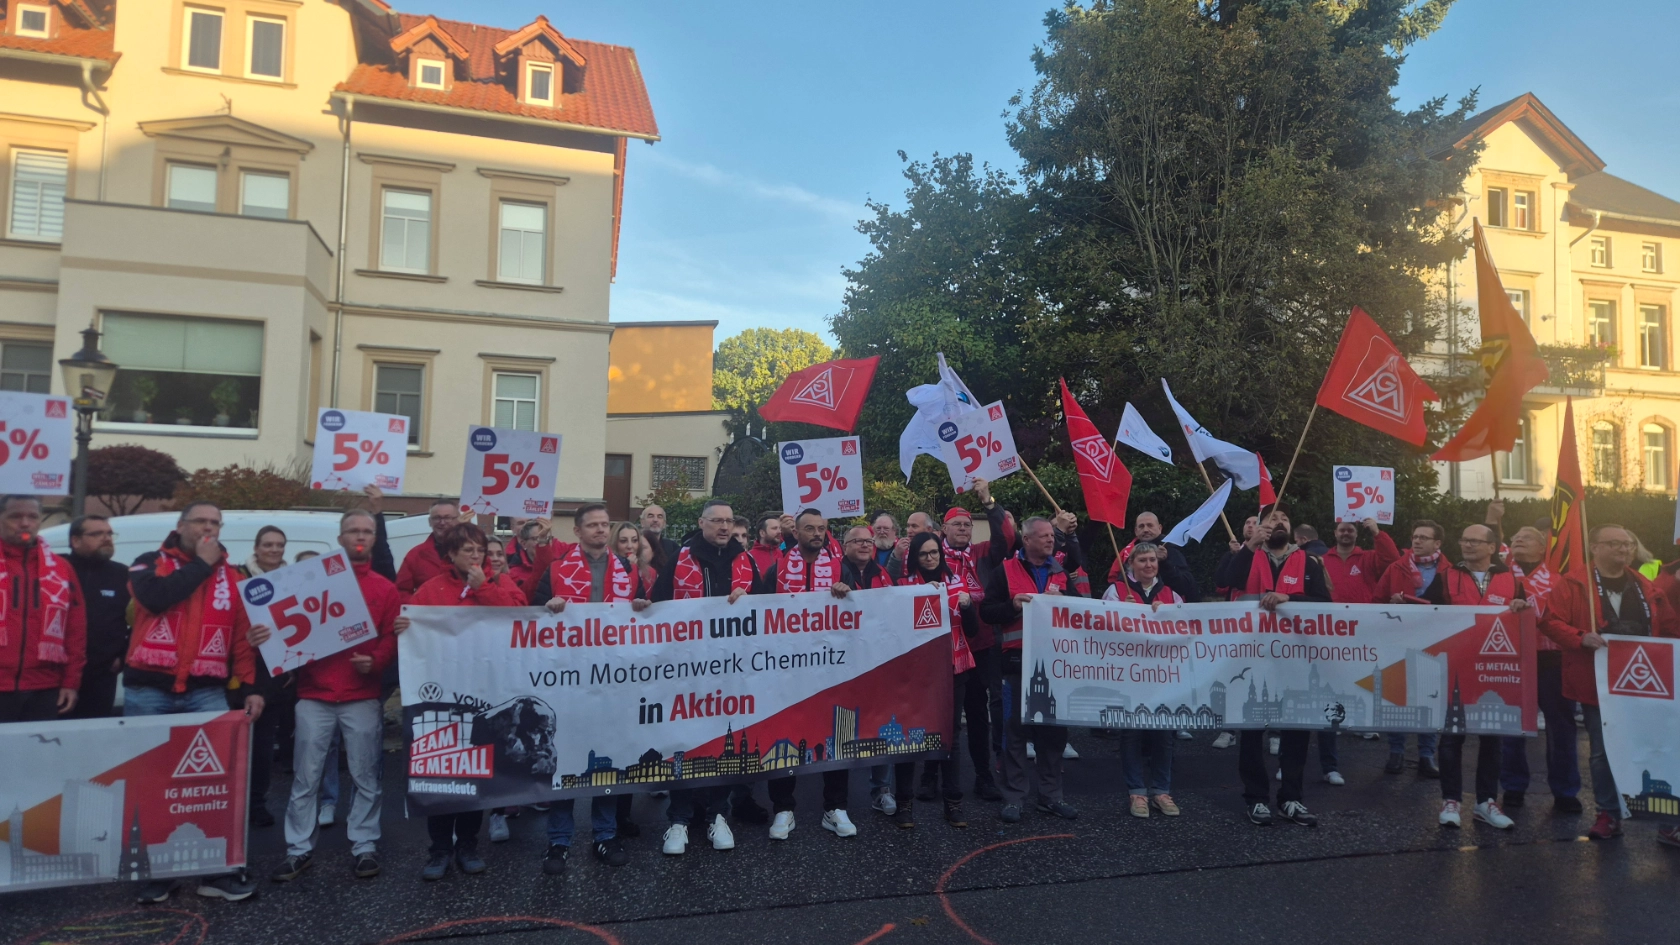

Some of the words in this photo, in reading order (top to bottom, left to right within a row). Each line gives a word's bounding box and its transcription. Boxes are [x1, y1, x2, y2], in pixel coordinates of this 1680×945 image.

[475, 434, 492, 442] WIR
[941, 426, 954, 435] WIR
[332, 433, 389, 471] 5%
[785, 448, 799, 456] WIR
[954, 431, 1003, 474] 5%
[482, 453, 540, 496] 5%
[795, 462, 848, 504] 5%
[1346, 482, 1385, 510] 5%
[248, 584, 268, 597] WIR
[268, 590, 345, 649] 5%
[510, 618, 703, 648] Metallerinnen
[710, 609, 757, 638] und
[763, 605, 862, 634] Metaller
[1051, 606, 1201, 636] Metallerinnen
[1208, 611, 1253, 635] und
[1258, 611, 1358, 637] Metaller
[1052, 638, 1079, 654] von
[1083, 637, 1190, 663] thyssenkrupp
[1194, 639, 1265, 663] Dynamic
[1270, 639, 1378, 663] Components
[528, 668, 580, 687] vom
[590, 652, 743, 685] Motorenwerk
[751, 646, 846, 672] Chemnitz
[1051, 659, 1125, 682] Chemnitz
[1129, 663, 1180, 683] GmbH
[1475, 663, 1485, 671] IG
[1487, 663, 1521, 672] METALL
[1478, 674, 1521, 684] Chemnitz
[638, 697, 663, 725] in
[669, 689, 755, 721] Aktion
[411, 726, 455, 755] TEAM
[411, 759, 423, 774] IG
[426, 748, 490, 775] METALL
[165, 788, 179, 800] IG
[181, 784, 229, 799] METALL
[410, 780, 477, 796] Vertrauensleute
[169, 800, 228, 814] Chemnitz
